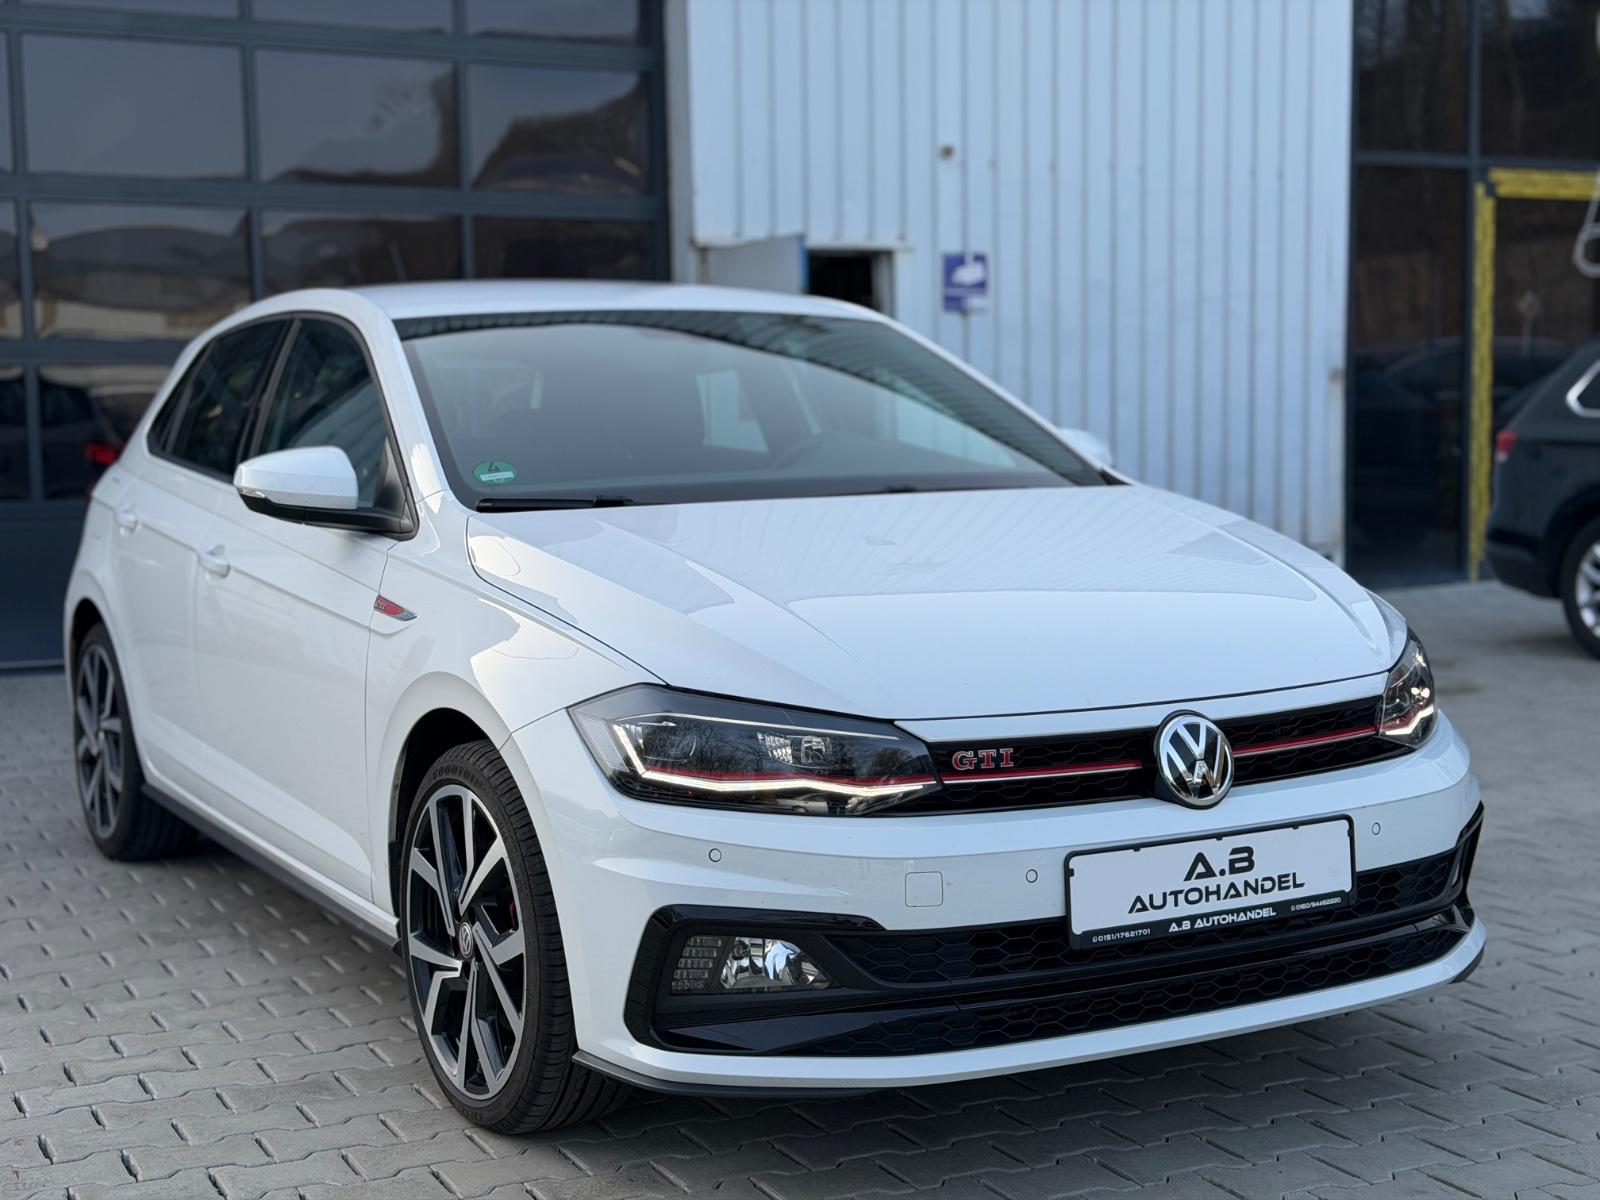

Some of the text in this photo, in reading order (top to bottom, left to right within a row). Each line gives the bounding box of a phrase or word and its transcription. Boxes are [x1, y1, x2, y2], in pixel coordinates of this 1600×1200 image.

[952, 748, 1014, 771] GTI
[1183, 846, 1255, 882] A.B
[1128, 872, 1305, 914] AUTOHANDEL
[1168, 920, 1191, 933] A.B
[1194, 907, 1277, 929] AUTOHANDEL
